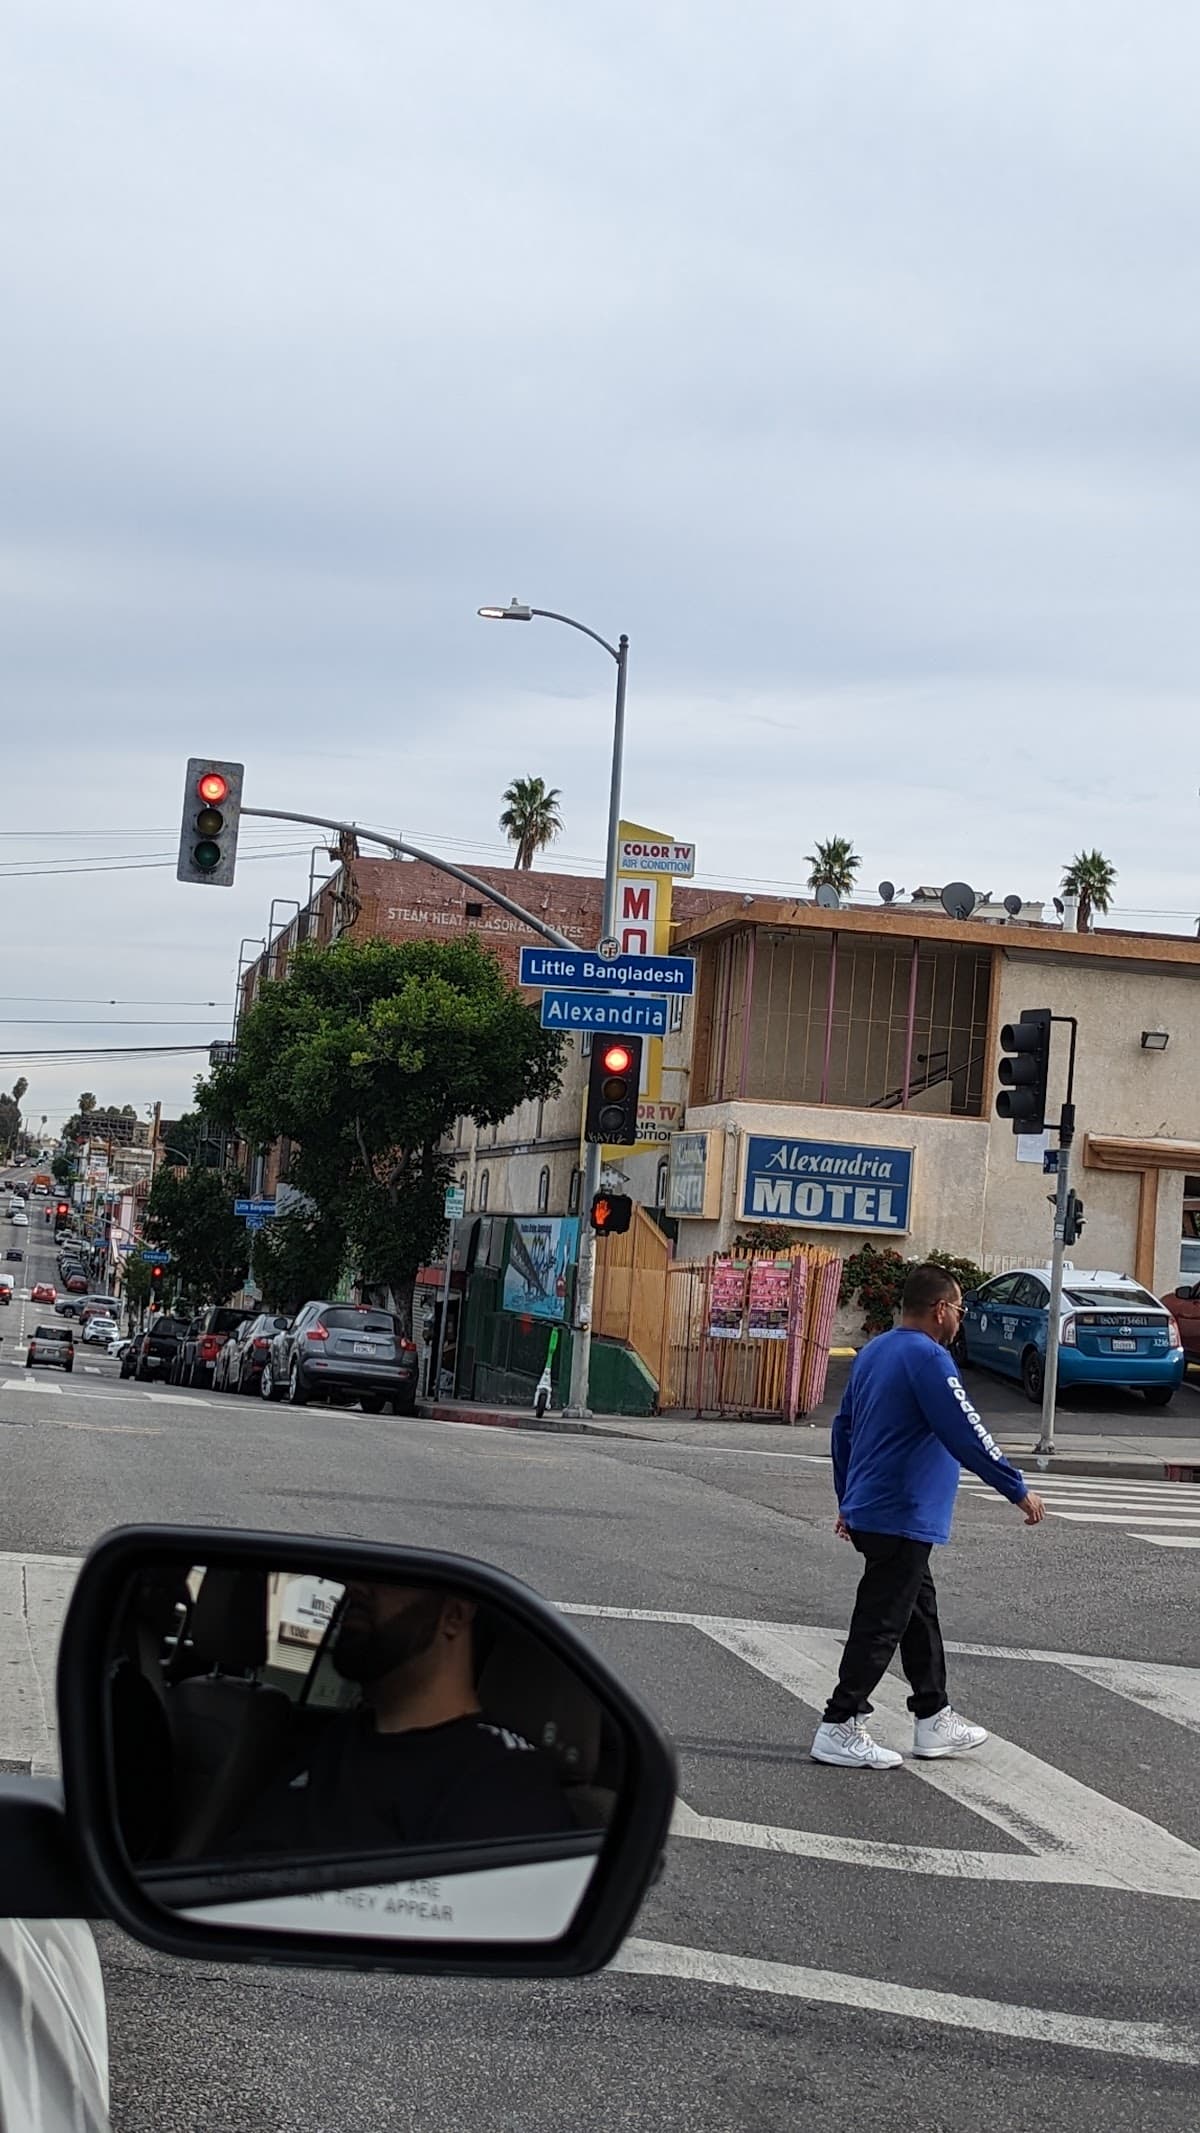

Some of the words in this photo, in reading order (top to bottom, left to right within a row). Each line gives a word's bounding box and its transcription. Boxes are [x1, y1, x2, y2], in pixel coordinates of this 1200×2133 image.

[623, 843, 670, 858] COLOR
[674, 847, 691, 859] TV
[622, 858, 637, 869] AIR
[640, 859, 691, 872] CONDITION
[387, 907, 428, 923] STEAM
[432, 912, 463, 927] HEAT
[530, 959, 576, 977] Little
[583, 962, 684, 984] Bangladesh
[547, 1000, 664, 1027] Alexandria
[659, 1106, 677, 1121] TV
[764, 1144, 893, 1179] Alexandria
[752, 1177, 898, 1224] MOTEL
[946, 1376, 1003, 1462] DODGERS
[384, 1897, 454, 1921] APPEAR
